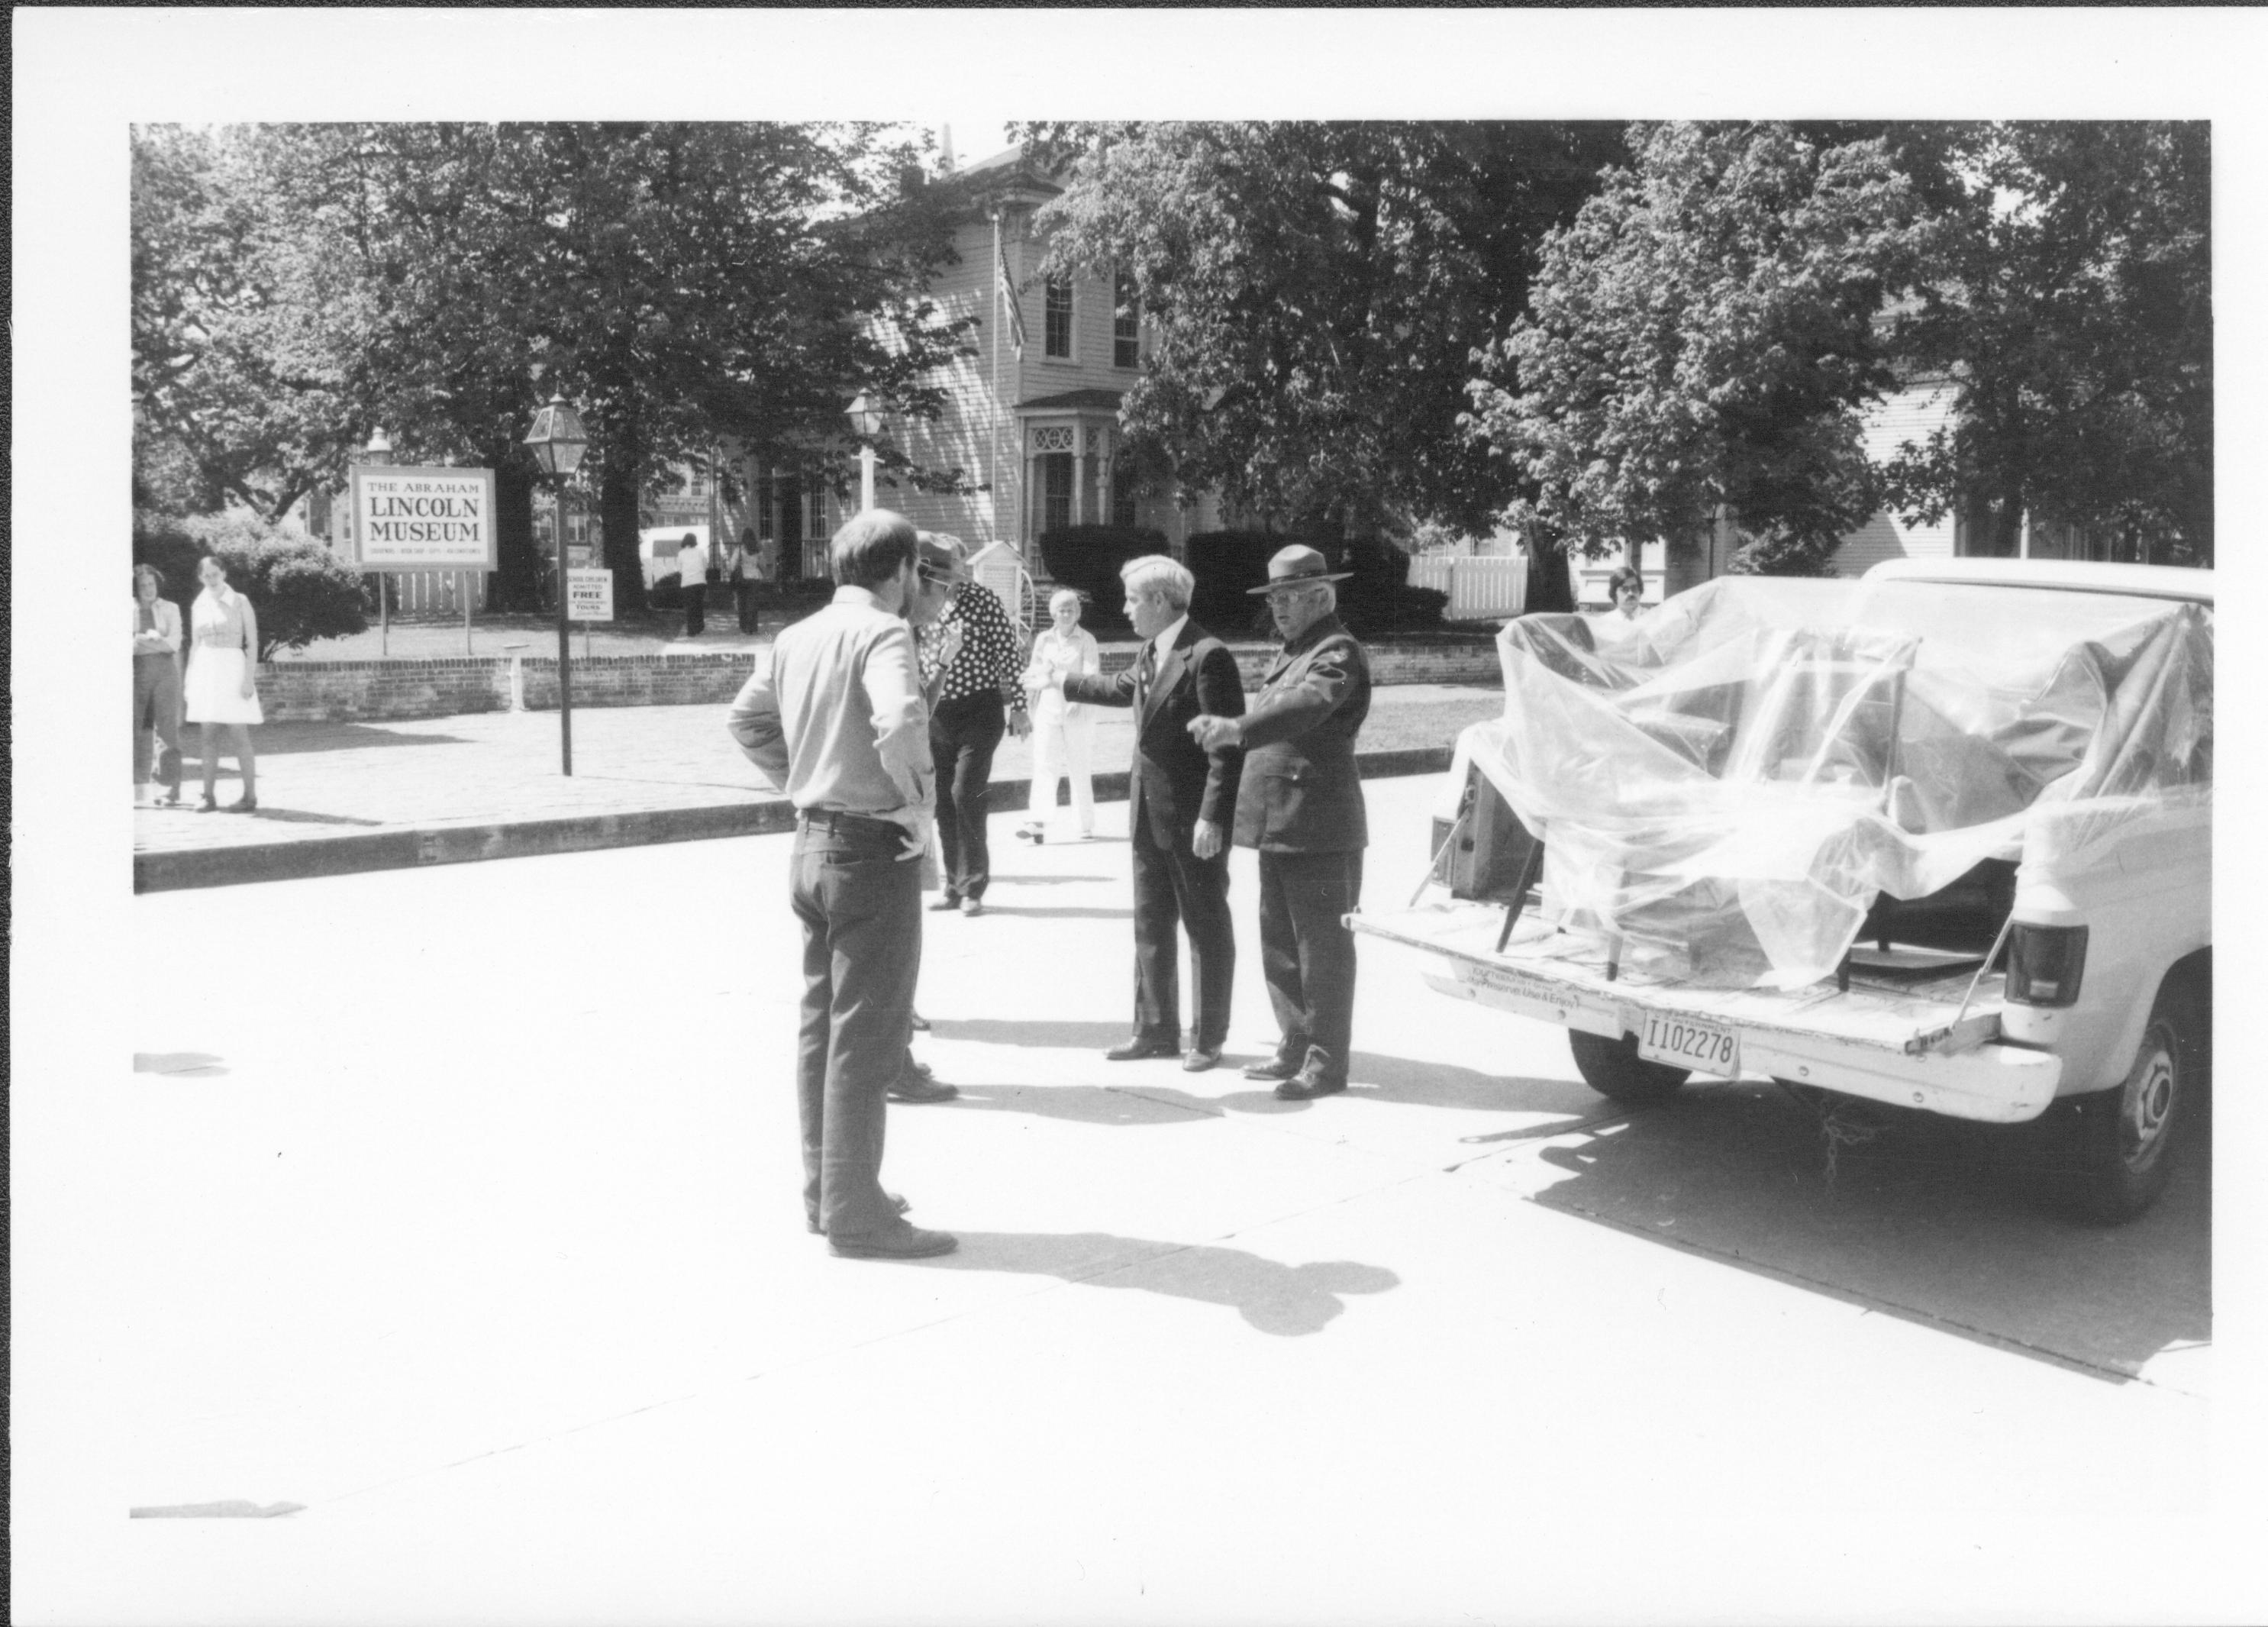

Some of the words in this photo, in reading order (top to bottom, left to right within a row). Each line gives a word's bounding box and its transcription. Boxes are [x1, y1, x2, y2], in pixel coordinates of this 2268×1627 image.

[367, 482, 398, 492] THE
[403, 483, 479, 493] ABRAHAM
[369, 496, 480, 518] LINCOLN
[369, 521, 480, 542] MUSEUM
